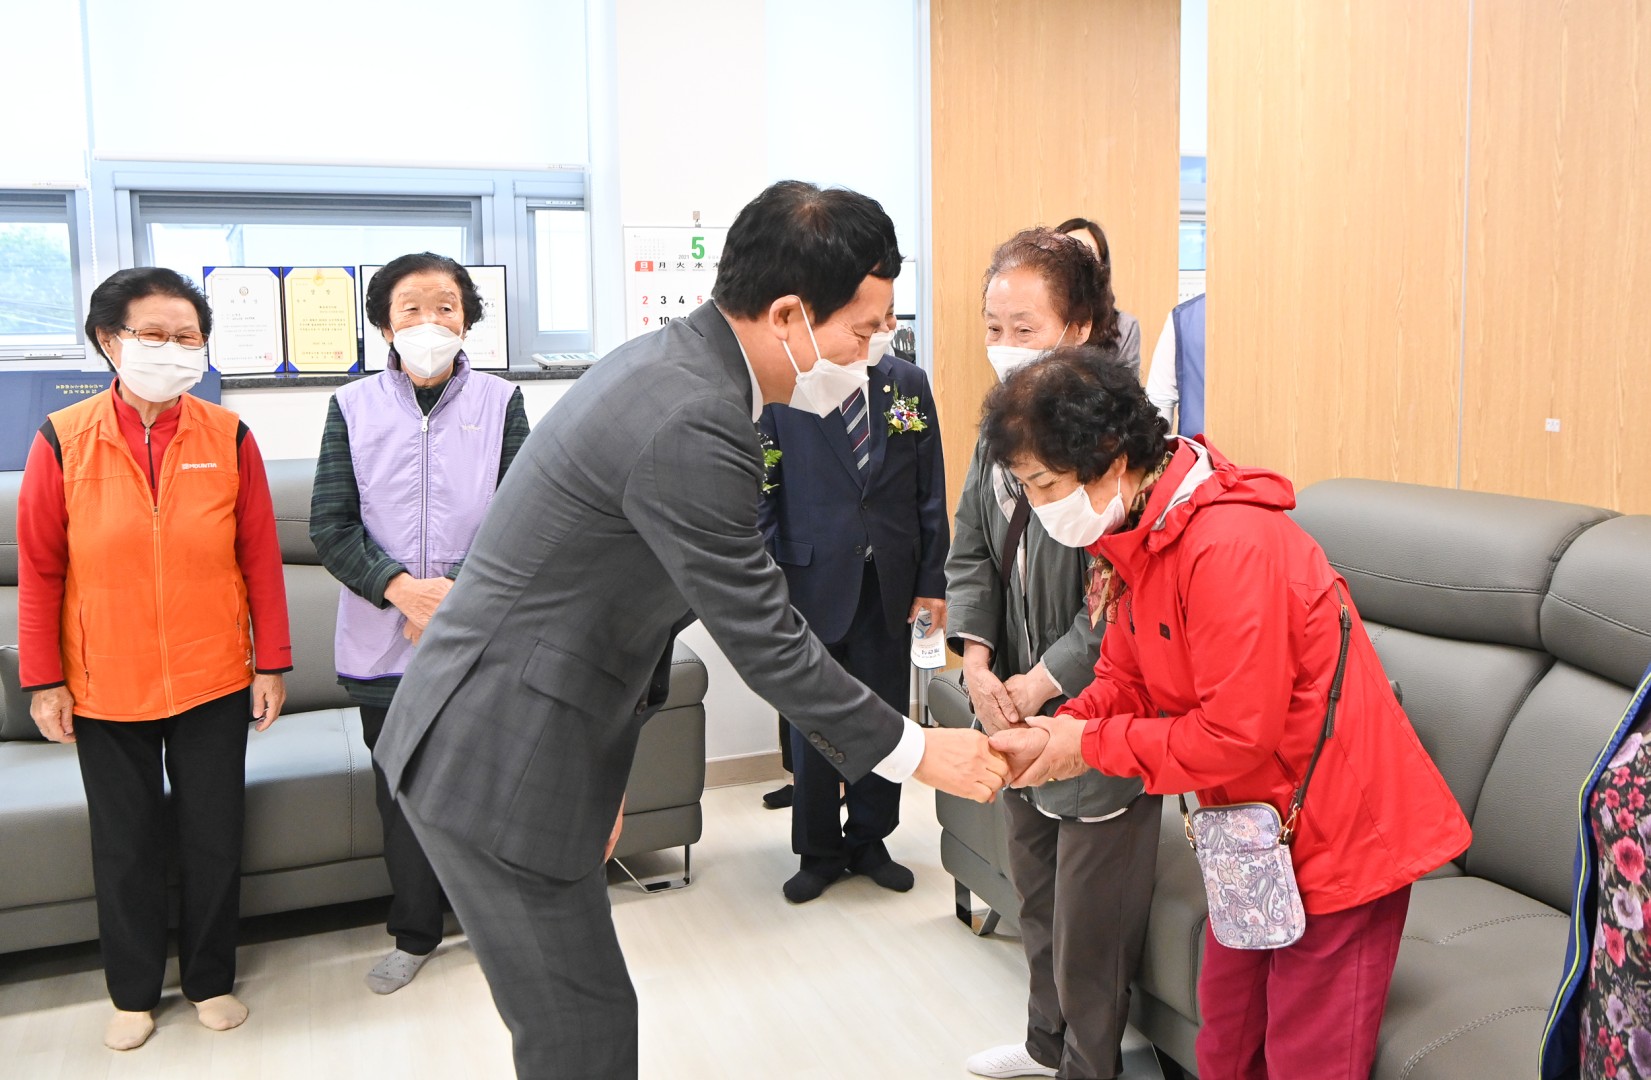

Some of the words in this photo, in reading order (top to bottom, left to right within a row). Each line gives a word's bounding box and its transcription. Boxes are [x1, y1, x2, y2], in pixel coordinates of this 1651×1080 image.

[692, 236, 705, 259] 5
[642, 296, 648, 304] 2
[661, 296, 667, 304] 3
[679, 296, 685, 304] 4
[697, 295, 703, 304] 5
[643, 317, 649, 325] 9
[659, 316, 670, 325] 10
